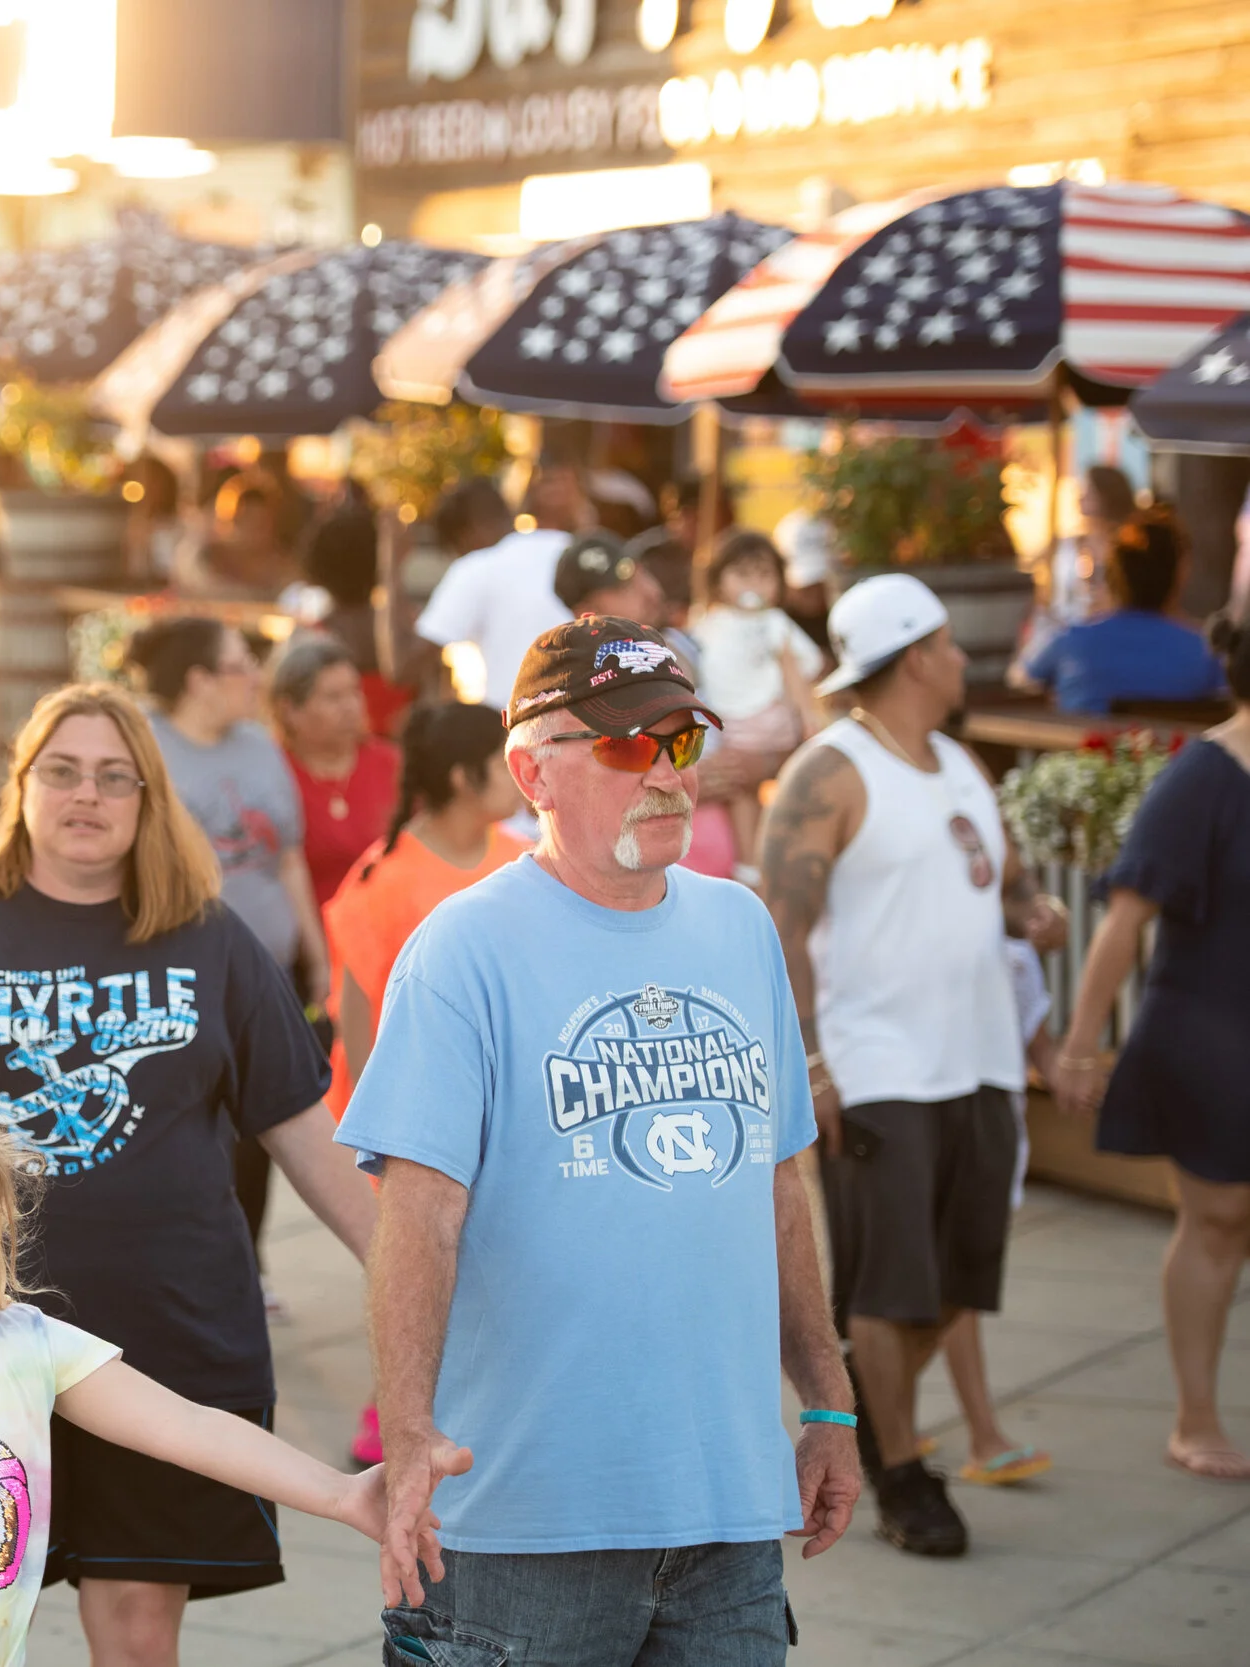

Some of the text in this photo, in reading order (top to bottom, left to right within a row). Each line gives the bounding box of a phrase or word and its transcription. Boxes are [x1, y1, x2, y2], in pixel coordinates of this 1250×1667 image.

[589, 669, 618, 688] EST.
[56, 965, 86, 982] UP!
[701, 986, 750, 1032] BASKETBALL
[91, 1002, 199, 1056] Beach
[604, 1022, 624, 1036] 20
[597, 1031, 736, 1066] NATIONAL
[549, 1043, 771, 1130] CHAMPIONS
[572, 1133, 595, 1160] 6
[558, 1157, 609, 1179] TIME
